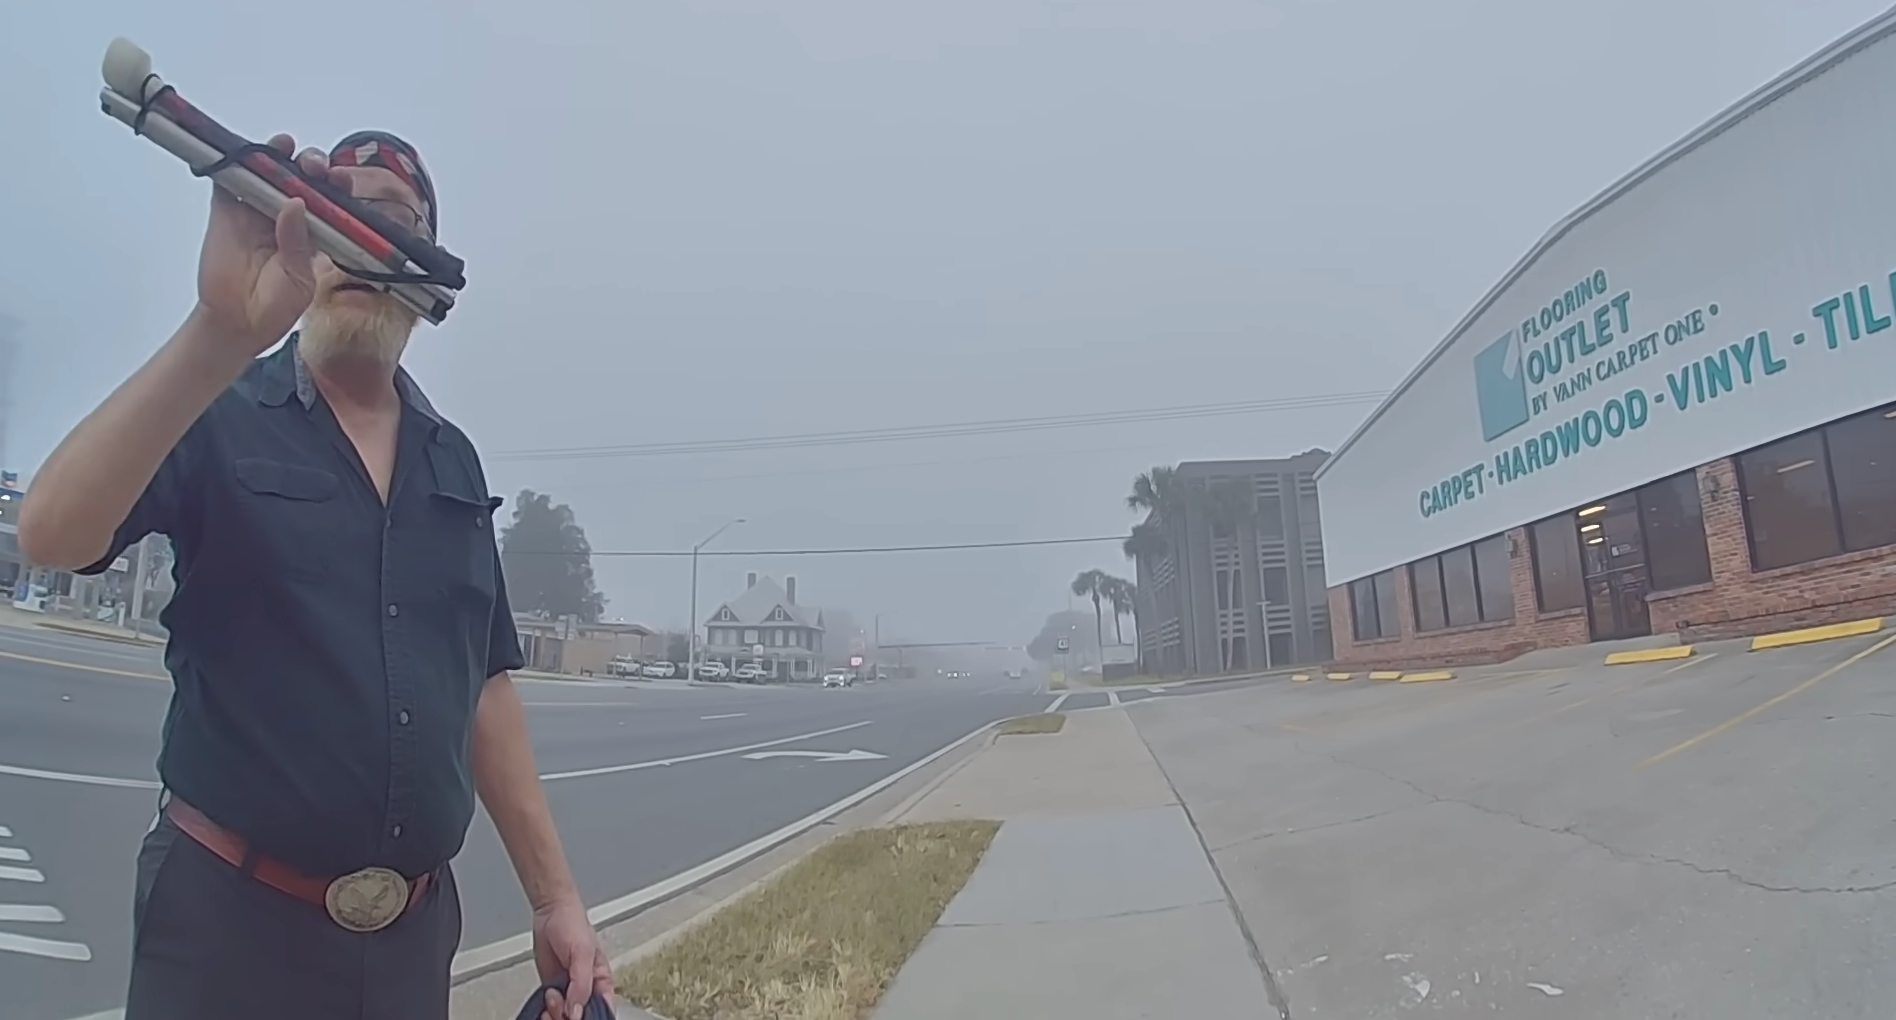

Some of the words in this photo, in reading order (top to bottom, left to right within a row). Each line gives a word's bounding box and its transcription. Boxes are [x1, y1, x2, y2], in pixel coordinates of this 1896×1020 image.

[1522, 269, 1607, 343] FLOORING
[1527, 291, 1631, 385] OUTLET
[1420, 464, 1485, 518] CARPET
[1495, 389, 1650, 485] HARDWOOD
[1665, 331, 1787, 411] VINYL
[1812, 271, 1896, 350] TIL
[1531, 391, 1549, 416] BY
[1552, 368, 1593, 403] VANN
[1595, 331, 1660, 382] CARPET
[1664, 309, 1705, 346] ONE
